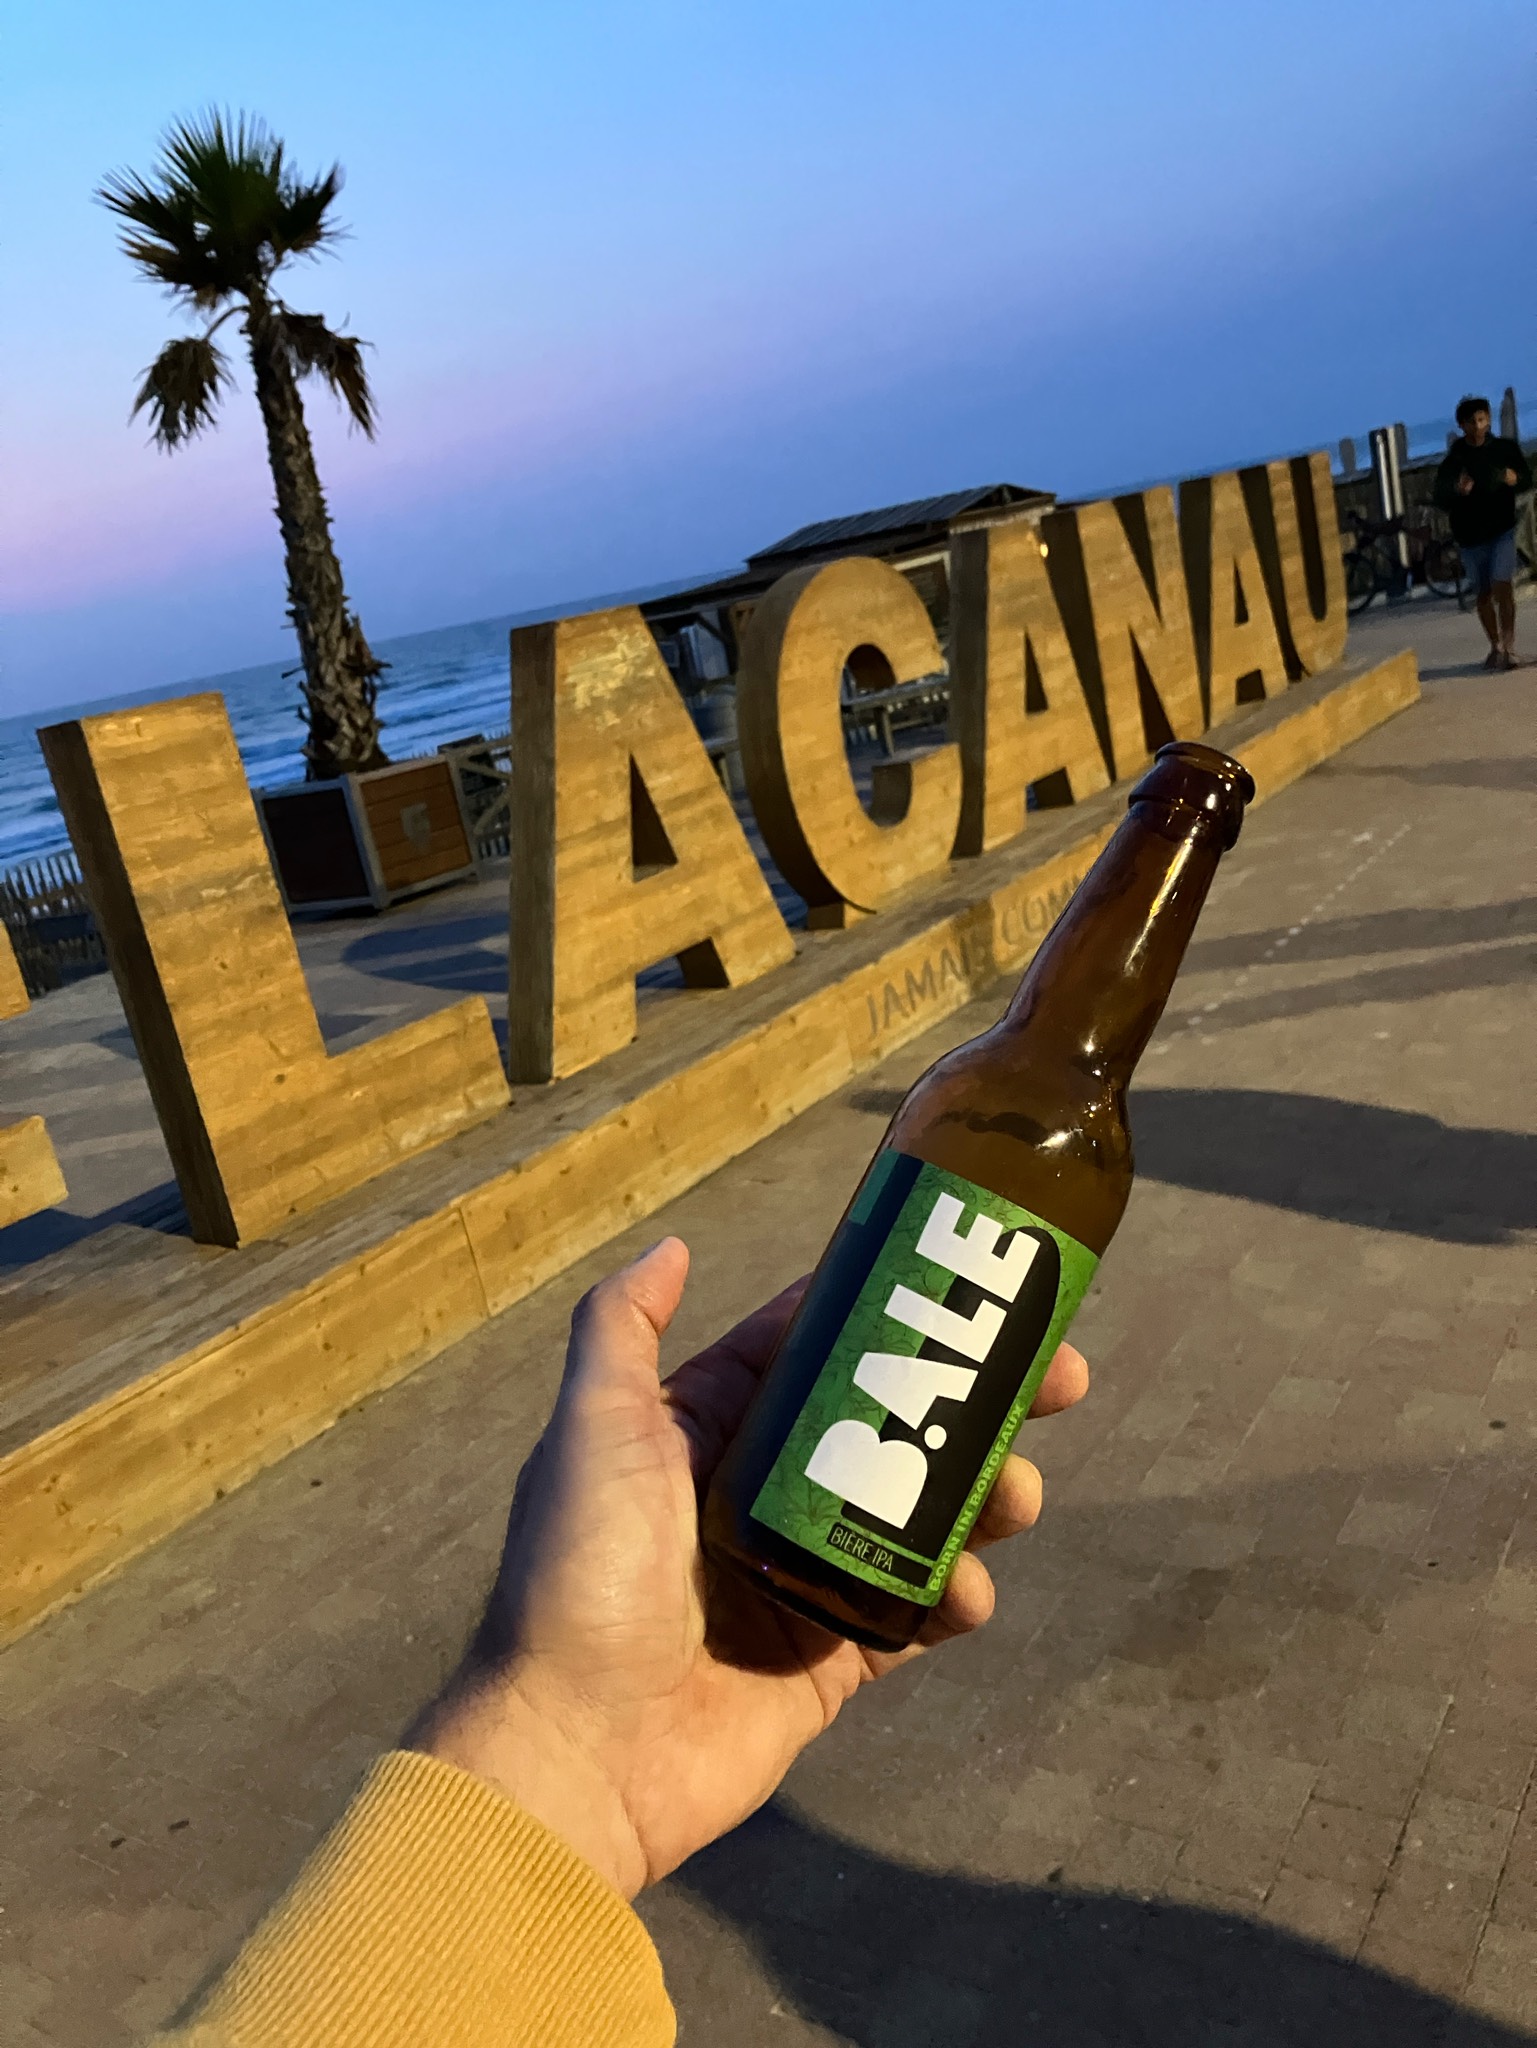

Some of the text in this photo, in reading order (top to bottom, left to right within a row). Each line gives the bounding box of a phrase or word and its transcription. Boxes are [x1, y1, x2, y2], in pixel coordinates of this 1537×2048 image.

[37, 451, 1348, 1248] LACANAU
[804, 1192, 1040, 1529] B.ALE
[830, 1526, 894, 1572] BIÈRE IPA
[929, 1403, 1025, 1591] BORN IN BORDEAUX
